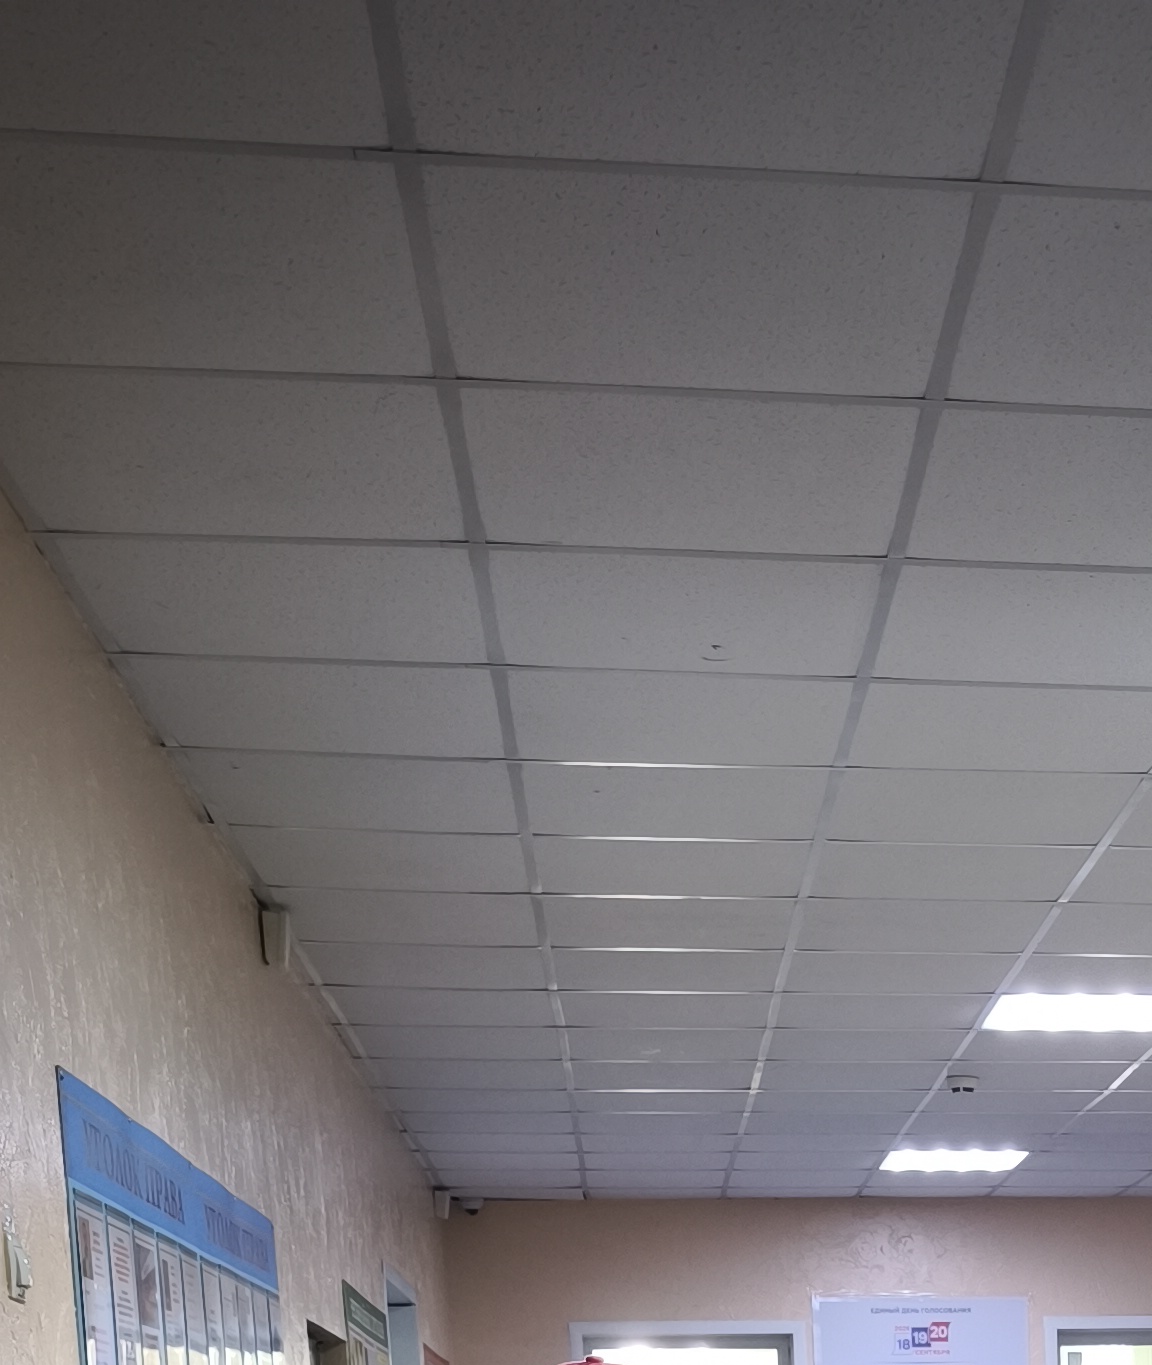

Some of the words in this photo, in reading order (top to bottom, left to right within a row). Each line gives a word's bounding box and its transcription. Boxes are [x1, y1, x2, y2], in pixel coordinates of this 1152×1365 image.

[82, 1117, 144, 1200] УГОЛОК
[145, 1165, 185, 1225] ПРАВА
[870, 1306, 900, 1314] ЕДИНЫЙ
[912, 1330, 928, 1345] 19
[929, 1325, 948, 1339] 20
[897, 1338, 911, 1351] 18
